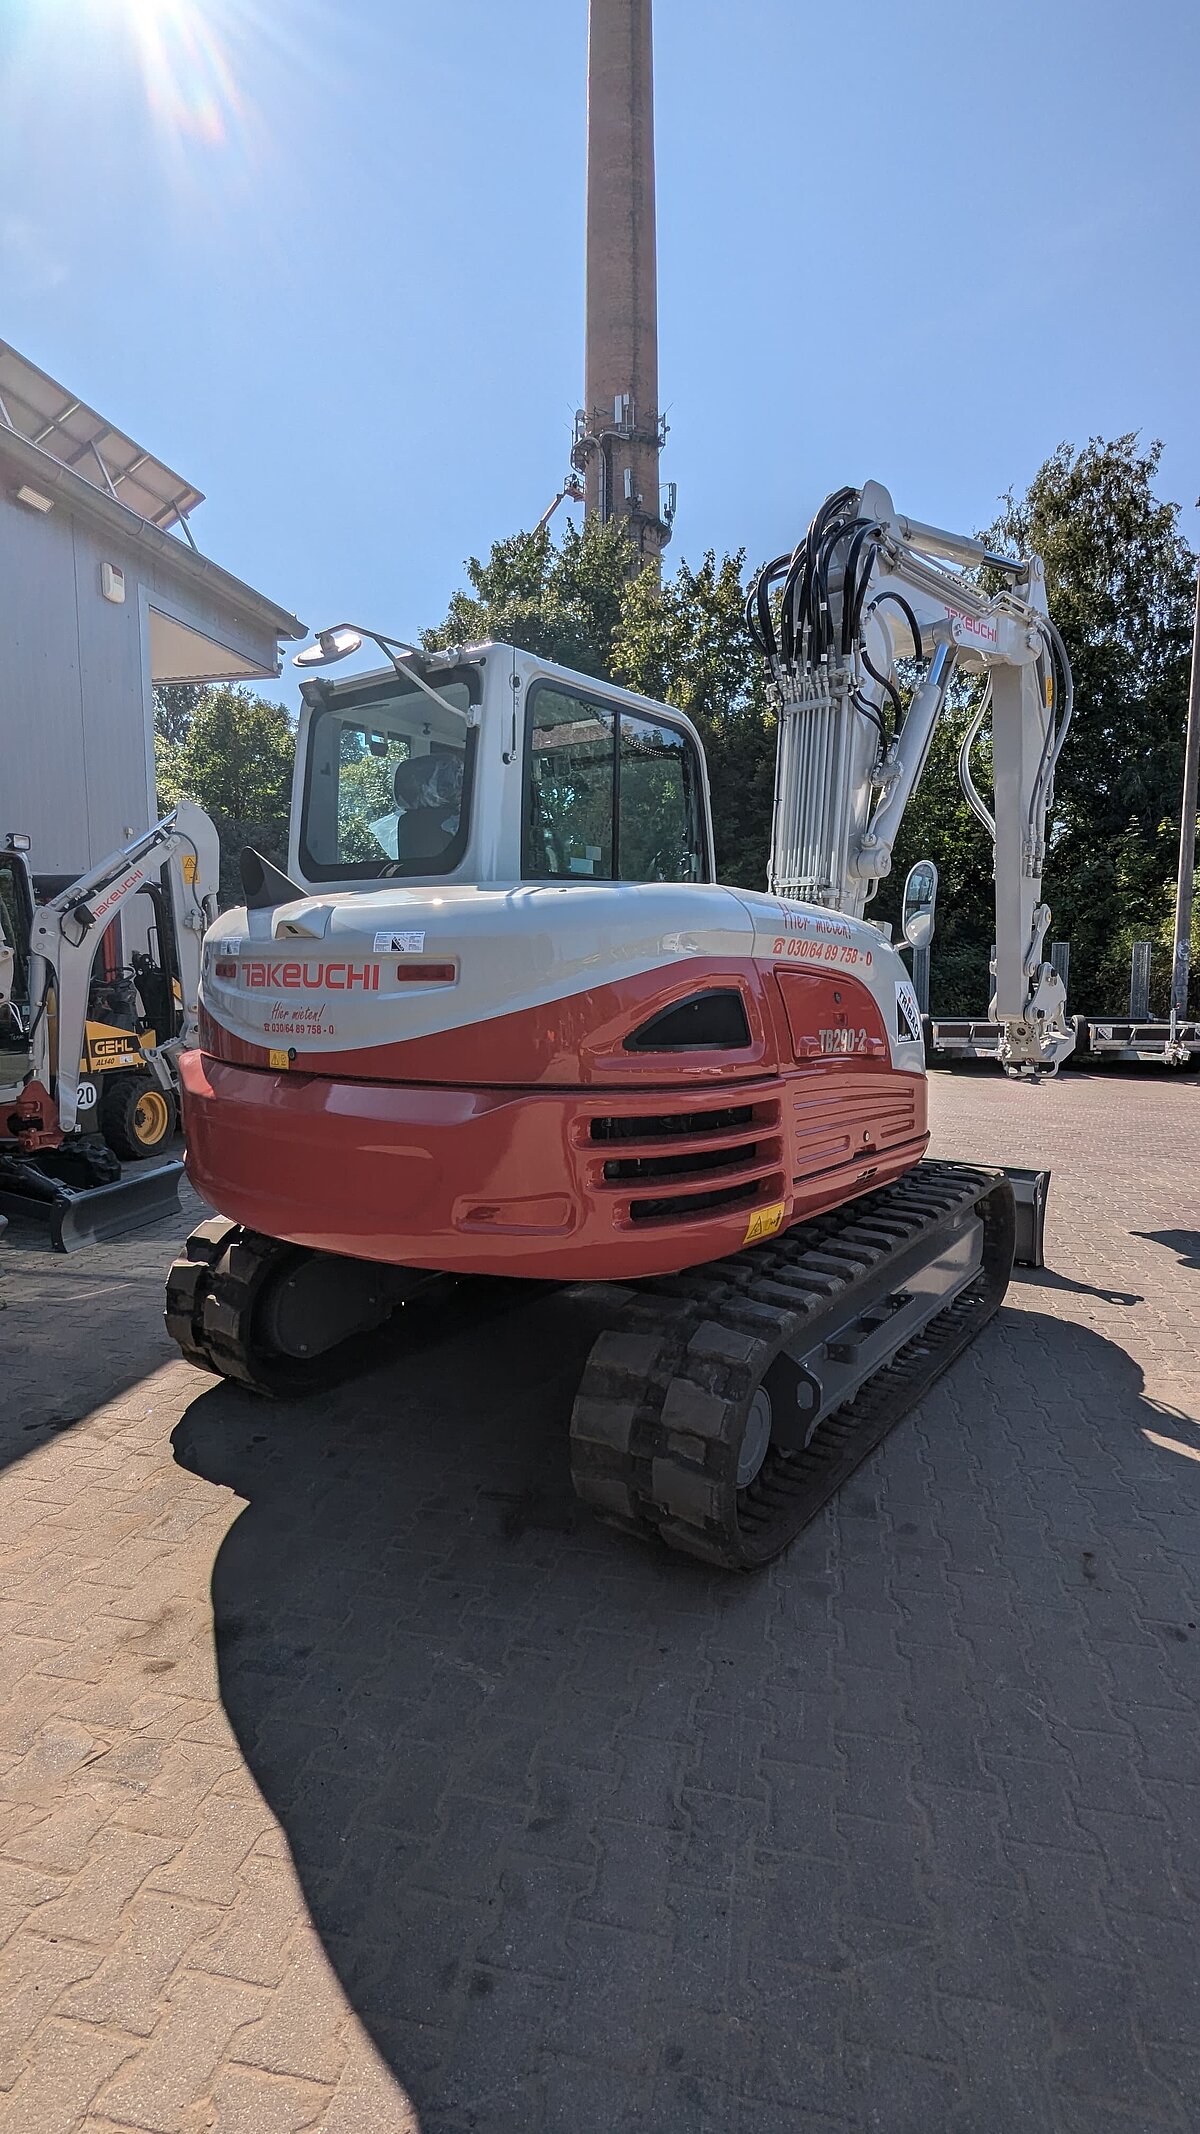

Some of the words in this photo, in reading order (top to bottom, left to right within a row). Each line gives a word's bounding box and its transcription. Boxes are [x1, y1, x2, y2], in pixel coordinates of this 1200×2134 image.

[777, 902, 811, 931] Hier
[787, 939, 823, 959] 030/64
[824, 944, 839, 961] 89
[840, 946, 859, 964] 758
[865, 951, 873, 966] 0
[271, 1001, 289, 1020] Hier
[292, 1003, 327, 1022] mieten!
[899, 986, 919, 1036] TRIBAC
[271, 1022, 294, 1033] 030/64
[295, 1024, 305, 1034] 89
[307, 1025, 321, 1035] 758
[328, 1024, 335, 1035] 0
[94, 1039, 134, 1055] GEHL
[818, 1028, 868, 1053] TB290-2
[95, 1057, 115, 1067] AL140
[76, 1086, 94, 1105] 20
